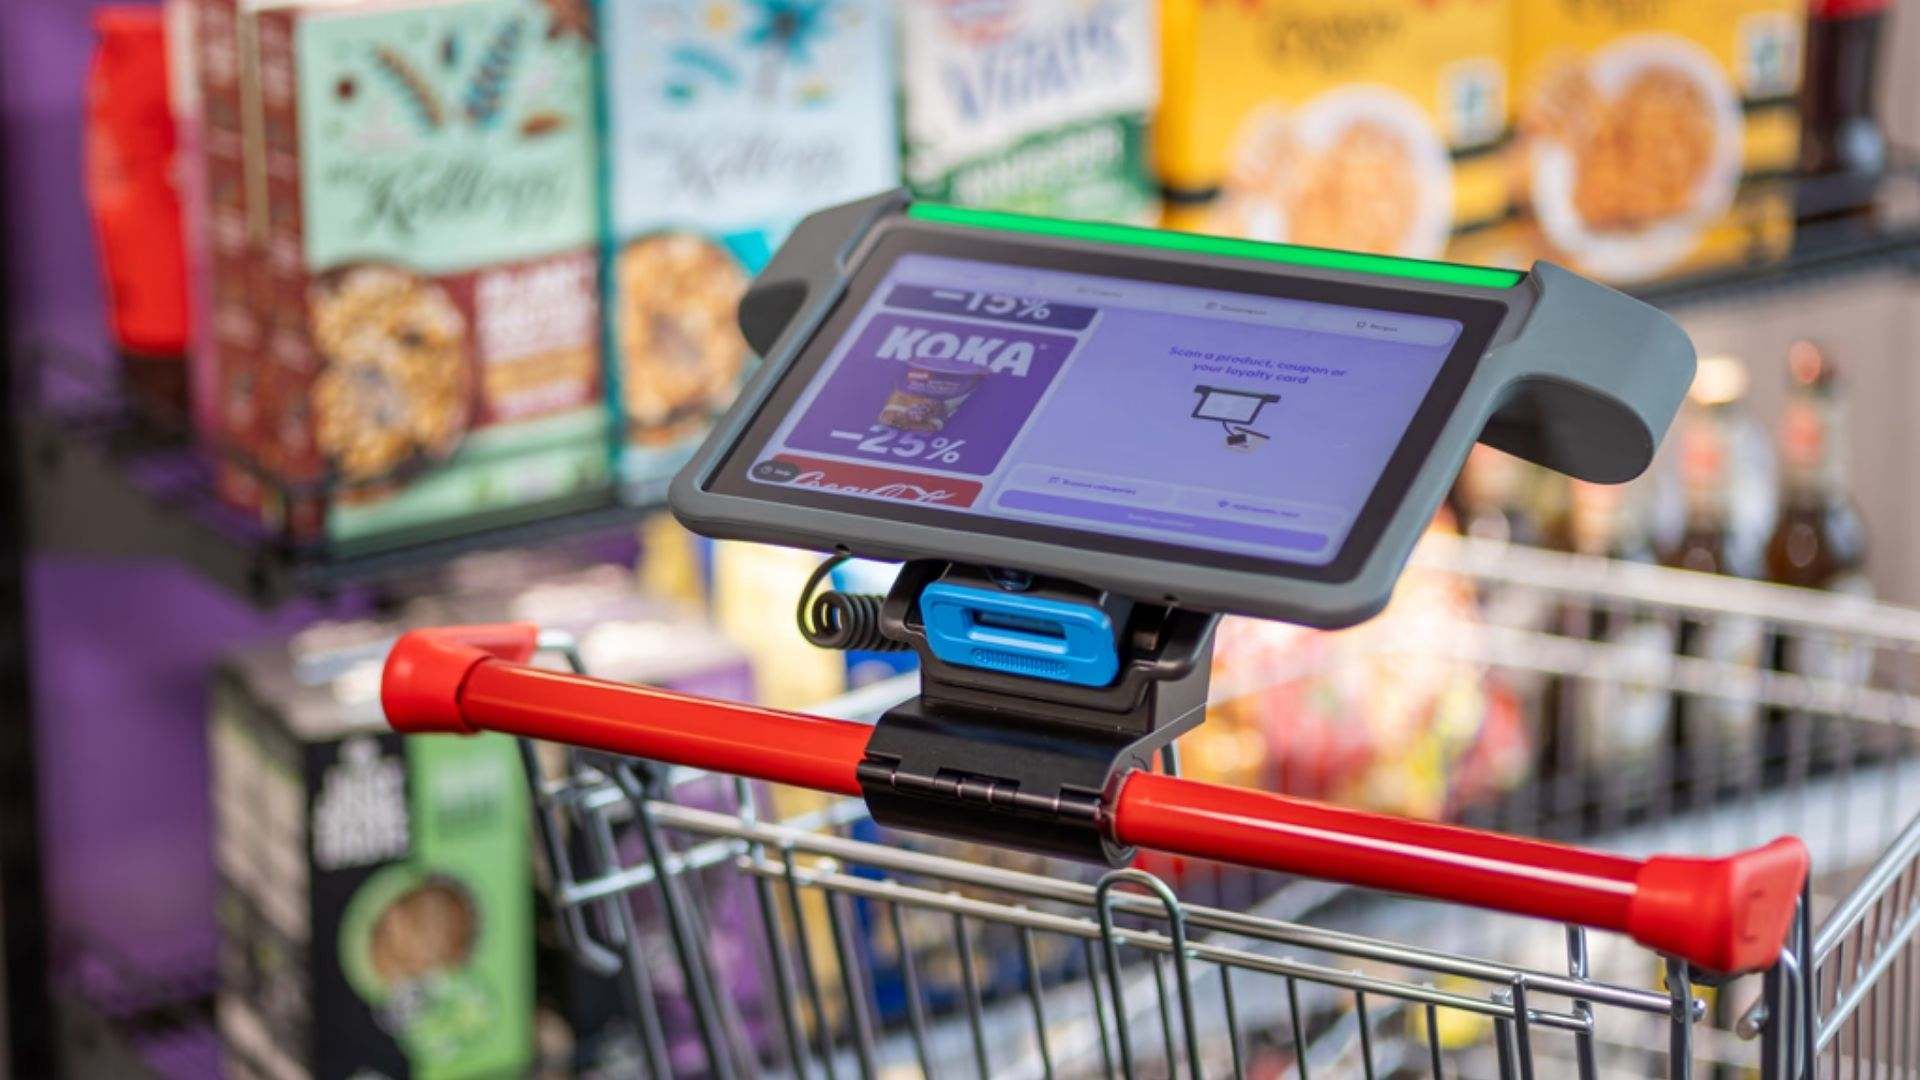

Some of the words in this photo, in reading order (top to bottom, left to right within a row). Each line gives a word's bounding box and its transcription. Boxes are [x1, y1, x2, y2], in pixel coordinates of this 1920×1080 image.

[876, 326, 1037, 377] KOKA
[1169, 346, 1202, 360] Scan
[1214, 351, 1273, 369] product,
[1277, 360, 1329, 376] coupon
[1331, 368, 1347, 377] or
[1192, 362, 1225, 374] your
[1226, 365, 1274, 382] loyalty
[1276, 372, 1309, 385] card
[830, 424, 967, 464] -25%
